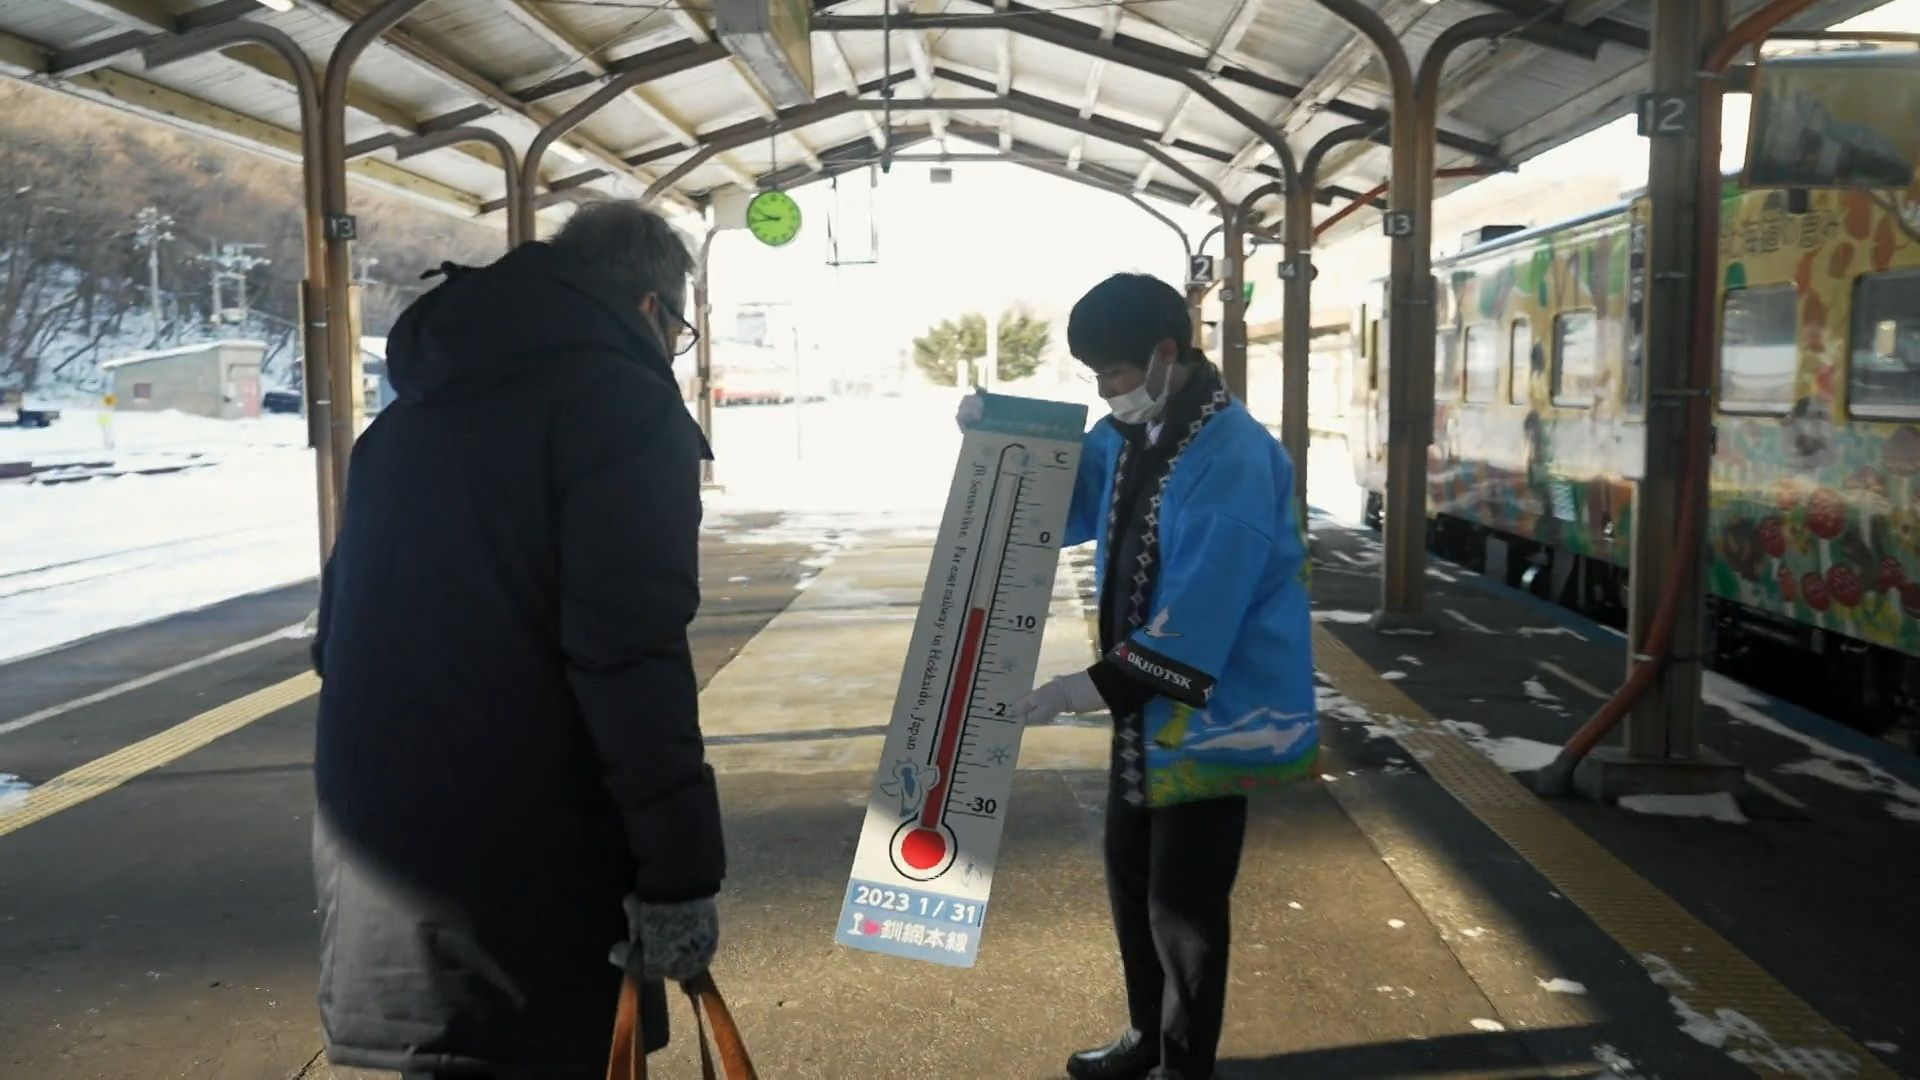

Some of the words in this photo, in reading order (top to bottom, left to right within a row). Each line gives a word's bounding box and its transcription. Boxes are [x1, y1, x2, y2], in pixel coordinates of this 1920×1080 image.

[1645, 97, 1687, 130] 12
[332, 217, 354, 238] 13
[1387, 211, 1411, 234] 13
[1193, 257, 1210, 280] 2
[973, 461, 987, 477] JR
[1039, 530, 1051, 545] 0
[1007, 614, 1037, 631] -10
[1126, 651, 1192, 690] OKHOTSK
[906, 713, 926, 751] Japan
[965, 796, 997, 815] -30
[853, 885, 910, 912] 2023
